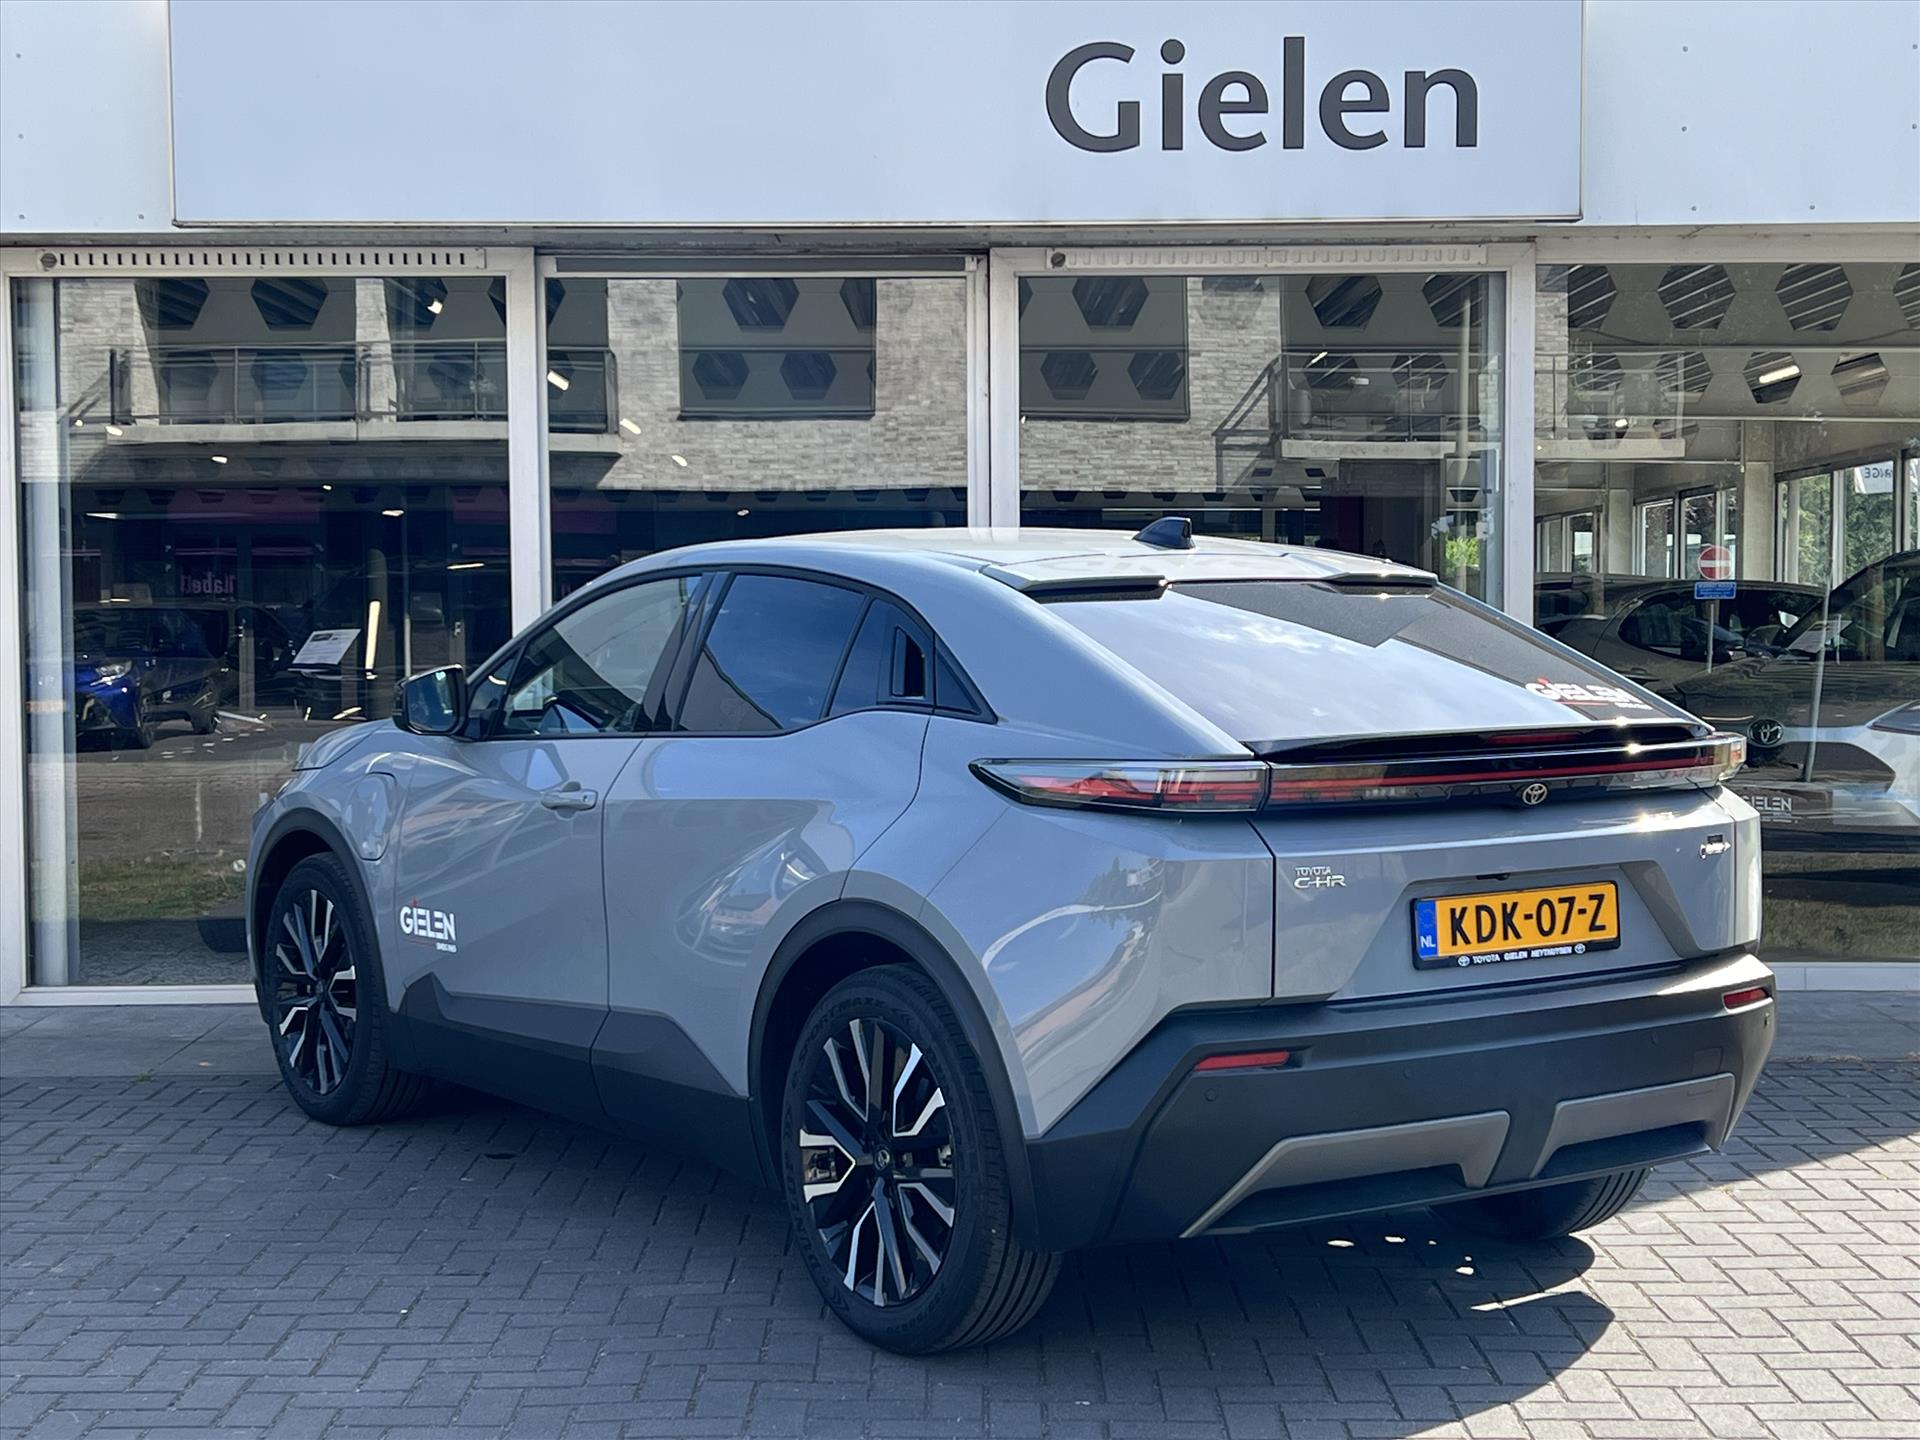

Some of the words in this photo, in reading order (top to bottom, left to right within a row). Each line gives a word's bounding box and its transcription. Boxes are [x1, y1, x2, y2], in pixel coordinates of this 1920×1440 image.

[1045, 36, 1478, 153] Gielen
[1295, 866, 1331, 877] TOYOTA
[1294, 875, 1347, 888] C-HR
[400, 906, 457, 941] GIELEN
[1450, 894, 1607, 947] KDK-07-Z
[1420, 935, 1436, 949] NL
[1473, 953, 1500, 964] TOYOTA
